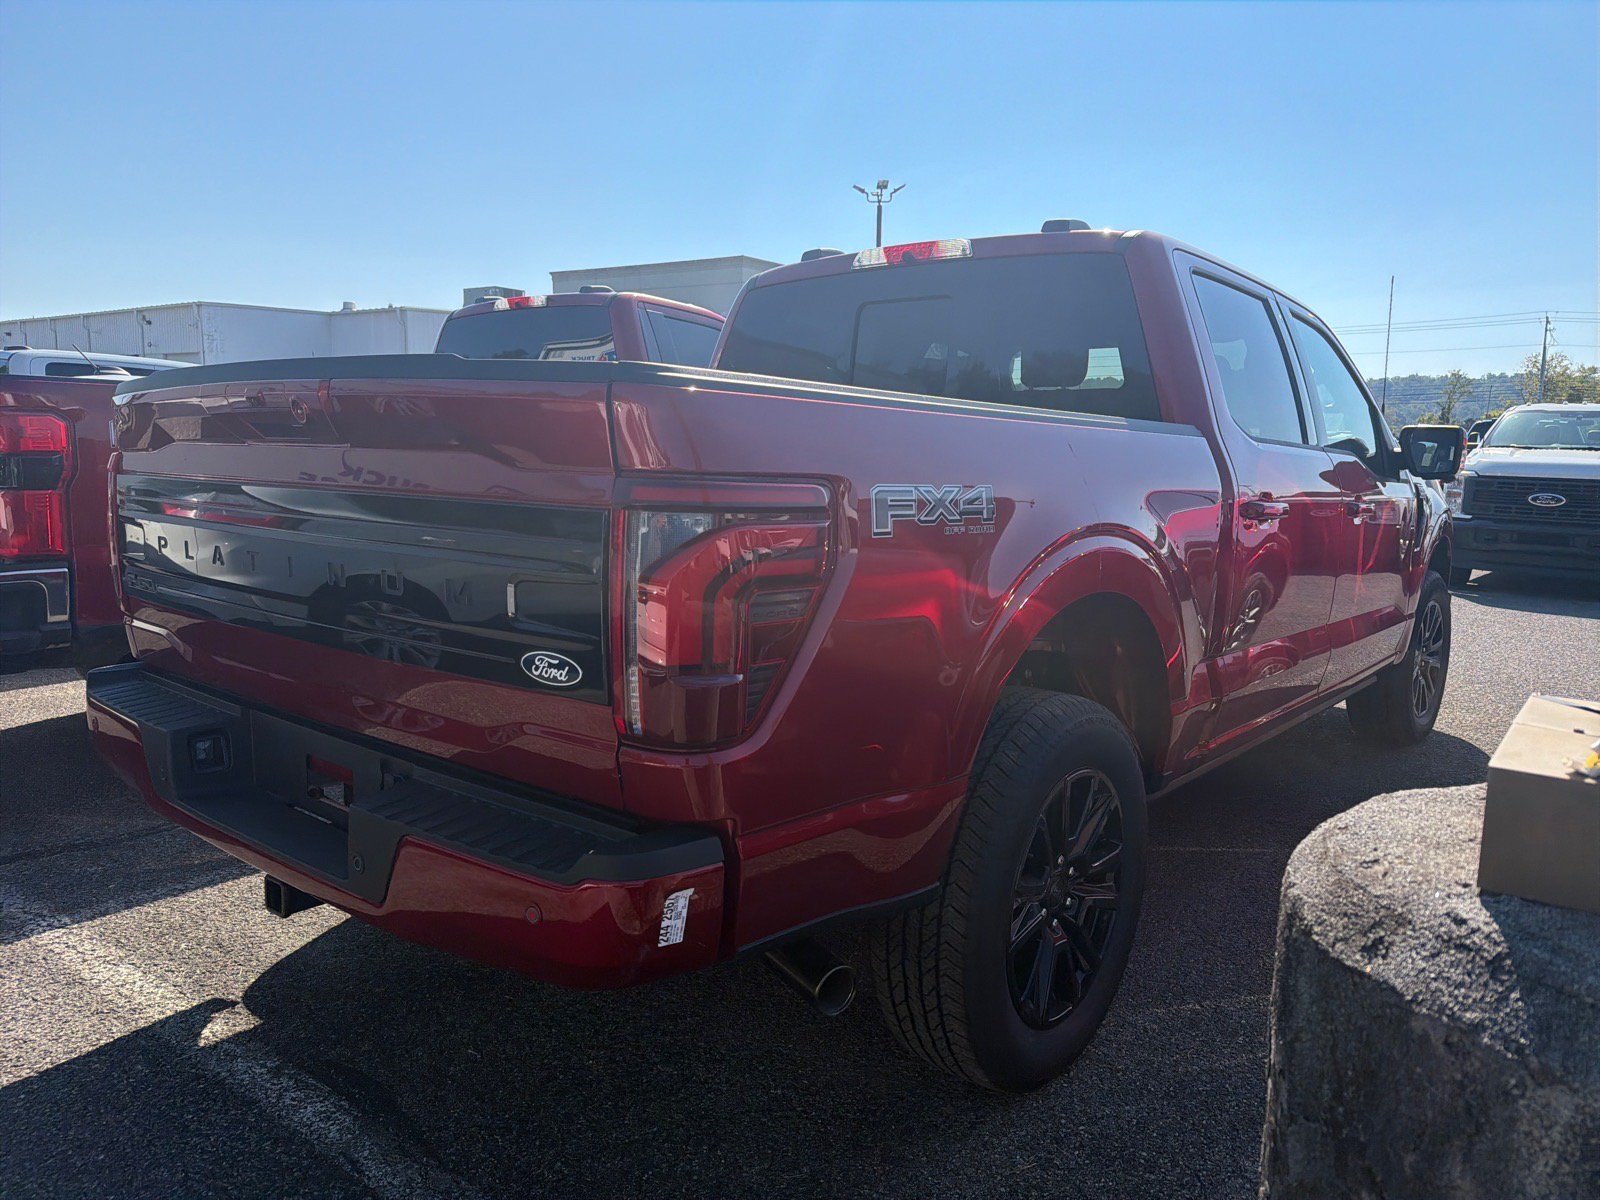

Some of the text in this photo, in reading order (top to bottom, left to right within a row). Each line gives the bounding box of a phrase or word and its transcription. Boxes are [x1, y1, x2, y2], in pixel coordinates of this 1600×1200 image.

[870, 484, 996, 538] FX4
[944, 524, 996, 535] OFF ROAD
[157, 535, 472, 607] PLATINUM
[530, 653, 570, 683] Ford
[658, 924, 671, 945] 244
